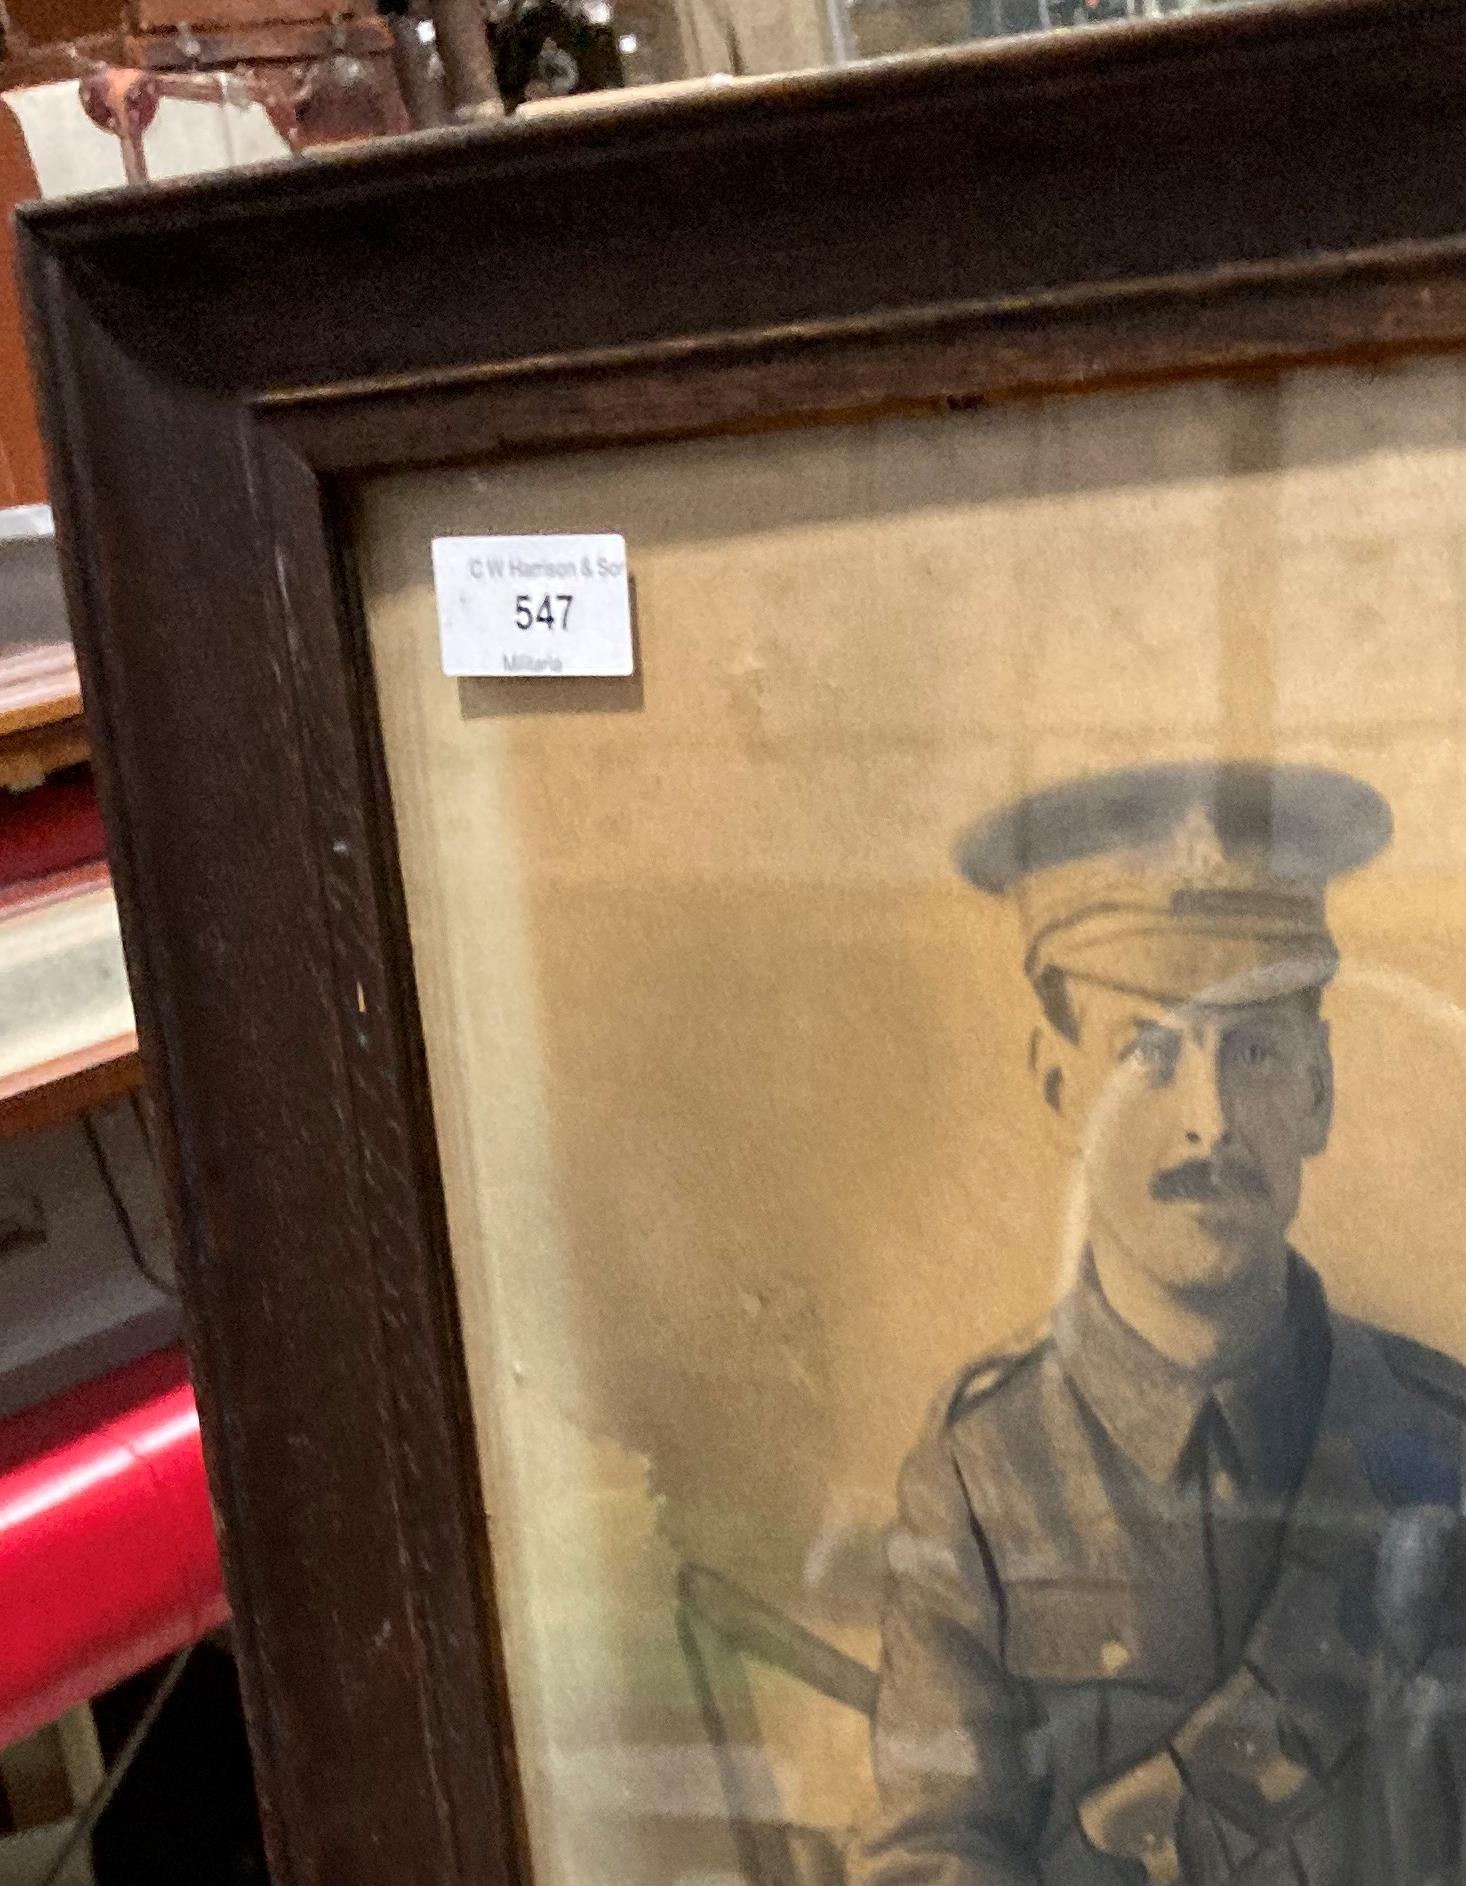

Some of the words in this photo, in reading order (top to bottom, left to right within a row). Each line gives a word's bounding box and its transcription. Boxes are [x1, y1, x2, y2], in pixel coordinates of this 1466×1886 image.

[468, 557, 484, 579] C
[487, 557, 504, 578] W
[581, 556, 594, 578] &
[597, 556, 625, 578] So
[515, 594, 574, 631] 547
